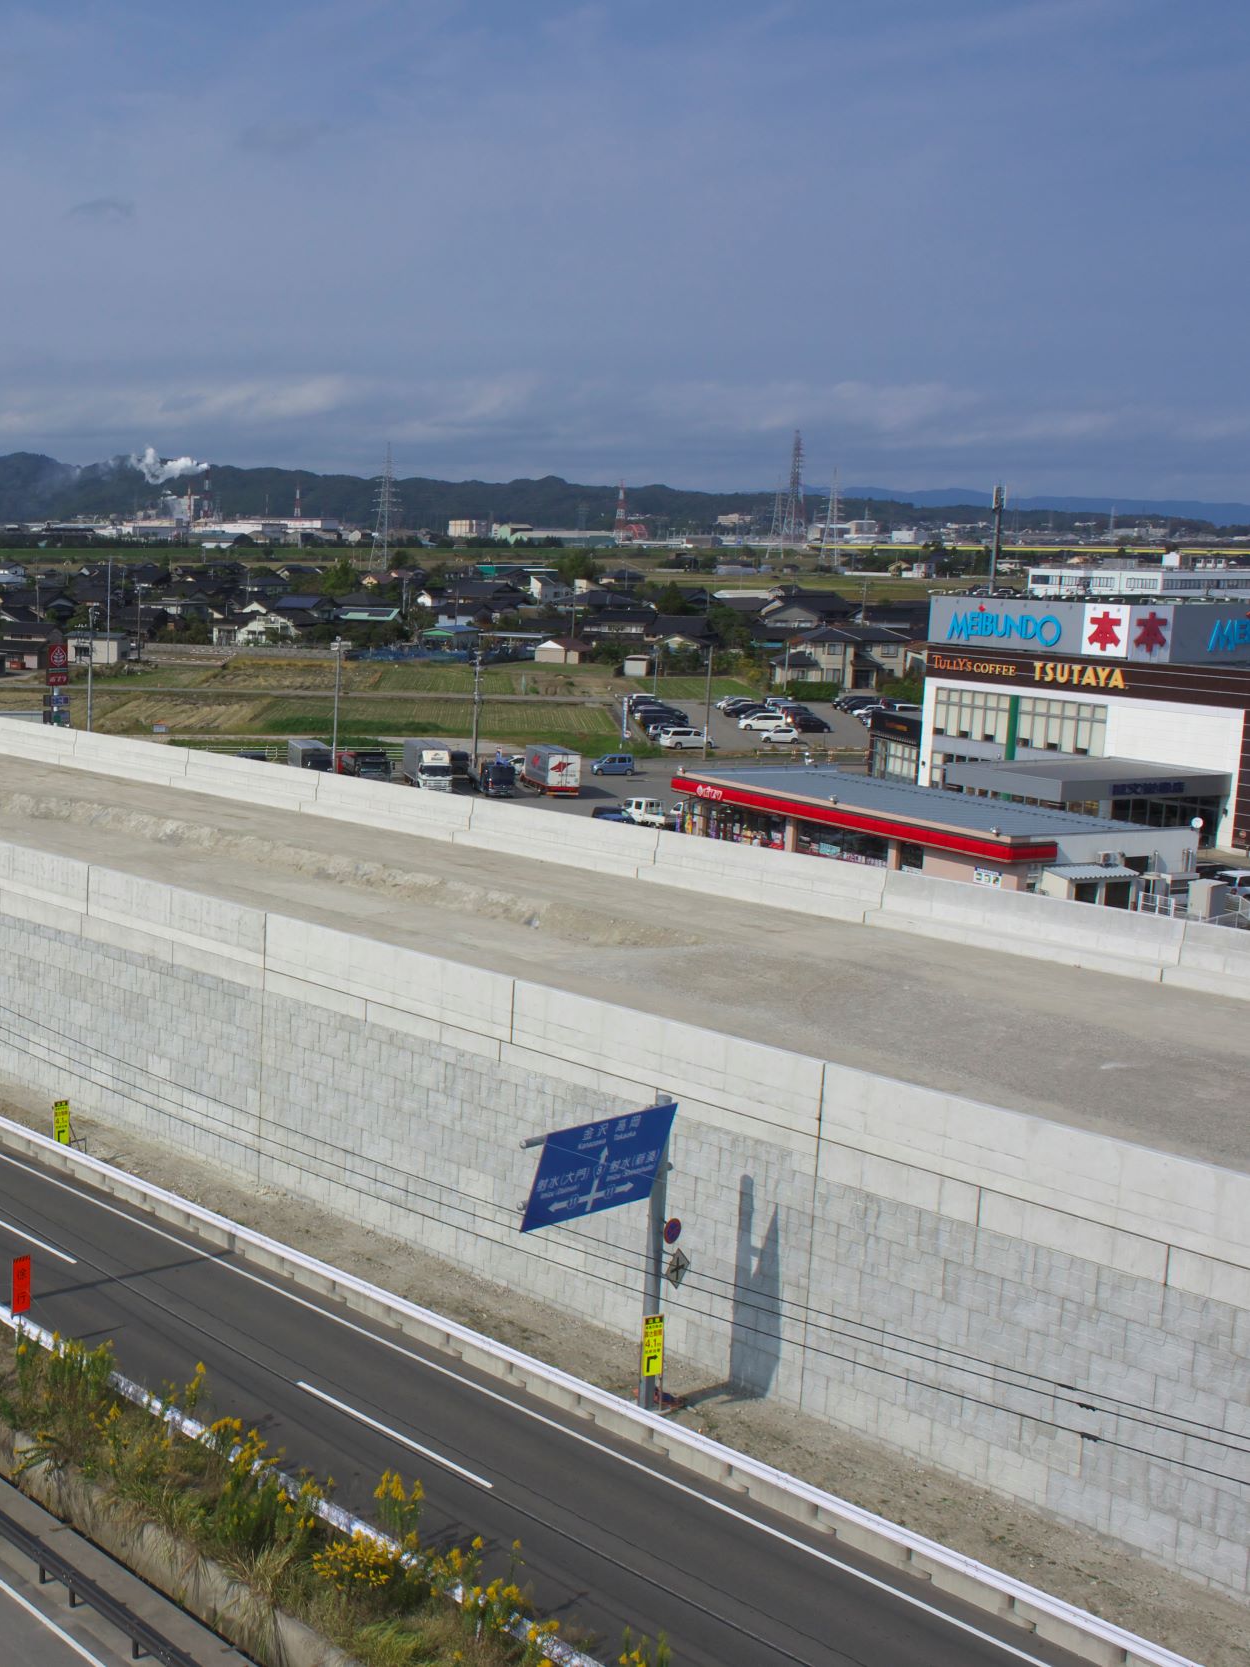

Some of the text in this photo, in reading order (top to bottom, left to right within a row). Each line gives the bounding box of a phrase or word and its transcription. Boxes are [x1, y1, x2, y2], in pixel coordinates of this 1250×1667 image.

[947, 605, 1061, 647] MEIBUNDO
[1087, 611, 1121, 652] 本
[973, 662, 1017, 677] COFFEE
[1033, 661, 1126, 690] TSUTAYA
[581, 1122, 609, 1141] 金沢
